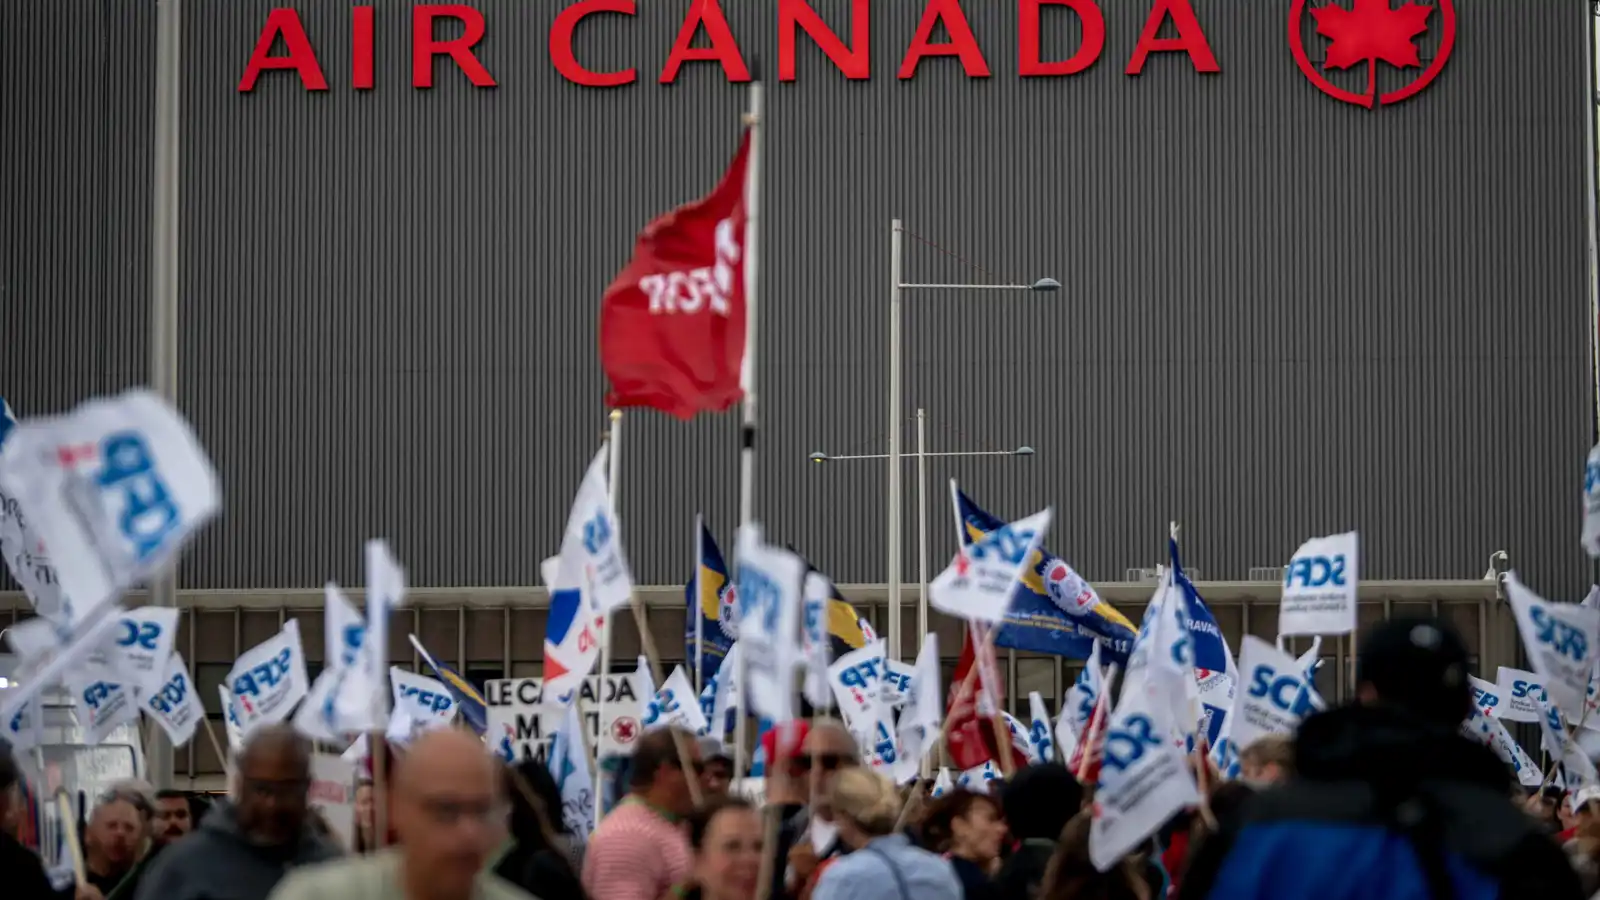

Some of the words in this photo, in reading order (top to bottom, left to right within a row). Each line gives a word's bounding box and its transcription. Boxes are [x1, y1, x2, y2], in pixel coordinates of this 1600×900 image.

[238, 5, 498, 92] AIR
[548, 0, 1221, 88] CANADA
[487, 682, 513, 706] LE
[516, 678, 635, 706] CADA
